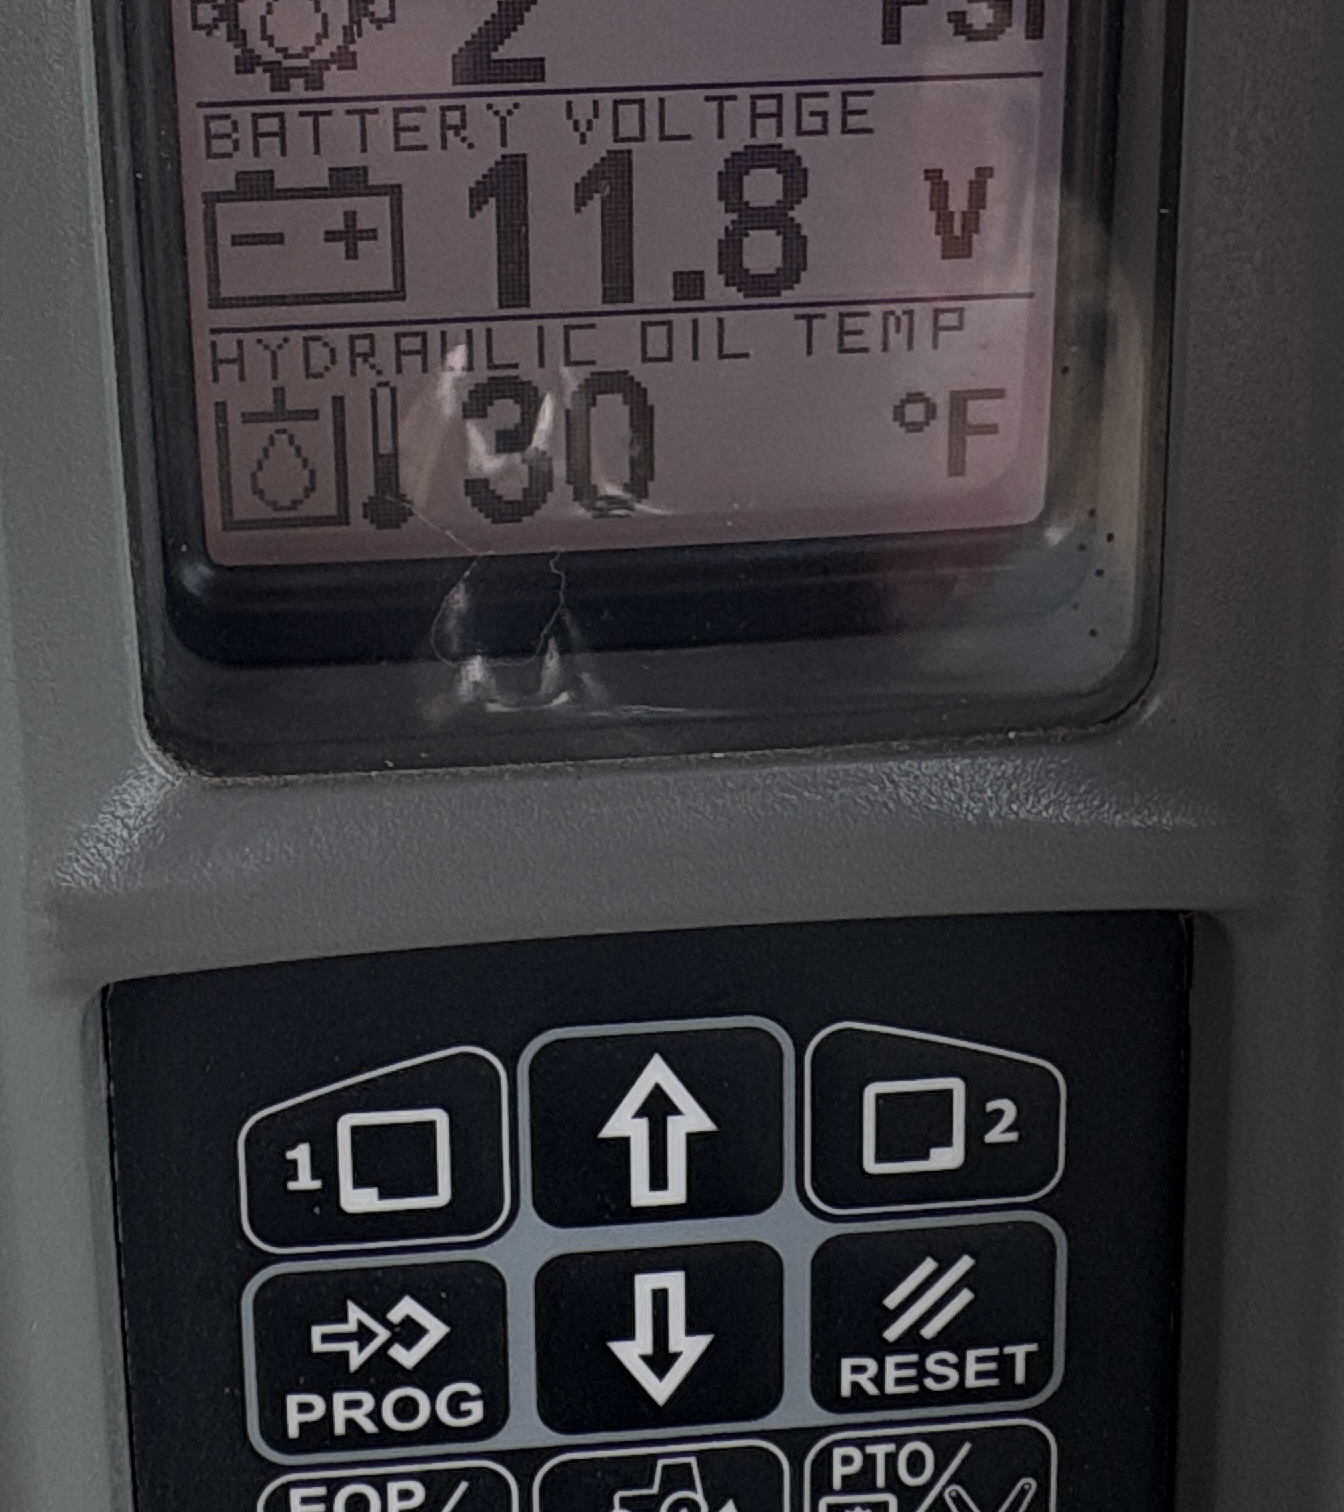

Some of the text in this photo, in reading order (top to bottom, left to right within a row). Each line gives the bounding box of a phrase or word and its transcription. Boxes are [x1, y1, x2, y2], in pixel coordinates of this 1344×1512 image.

[202, 89, 876, 161] BATTERY VOLTAGE
[467, 142, 809, 311] 11.8
[922, 165, 996, 261] V
[209, 304, 968, 385] HYDRAULIC OIL TEMP
[460, 369, 656, 526] 30
[891, 385, 1008, 479] °F
[981, 1098, 1020, 1145] 2
[284, 1141, 323, 1194] 1
[838, 1342, 1039, 1399] RESET
[284, 1381, 485, 1440] PROG
